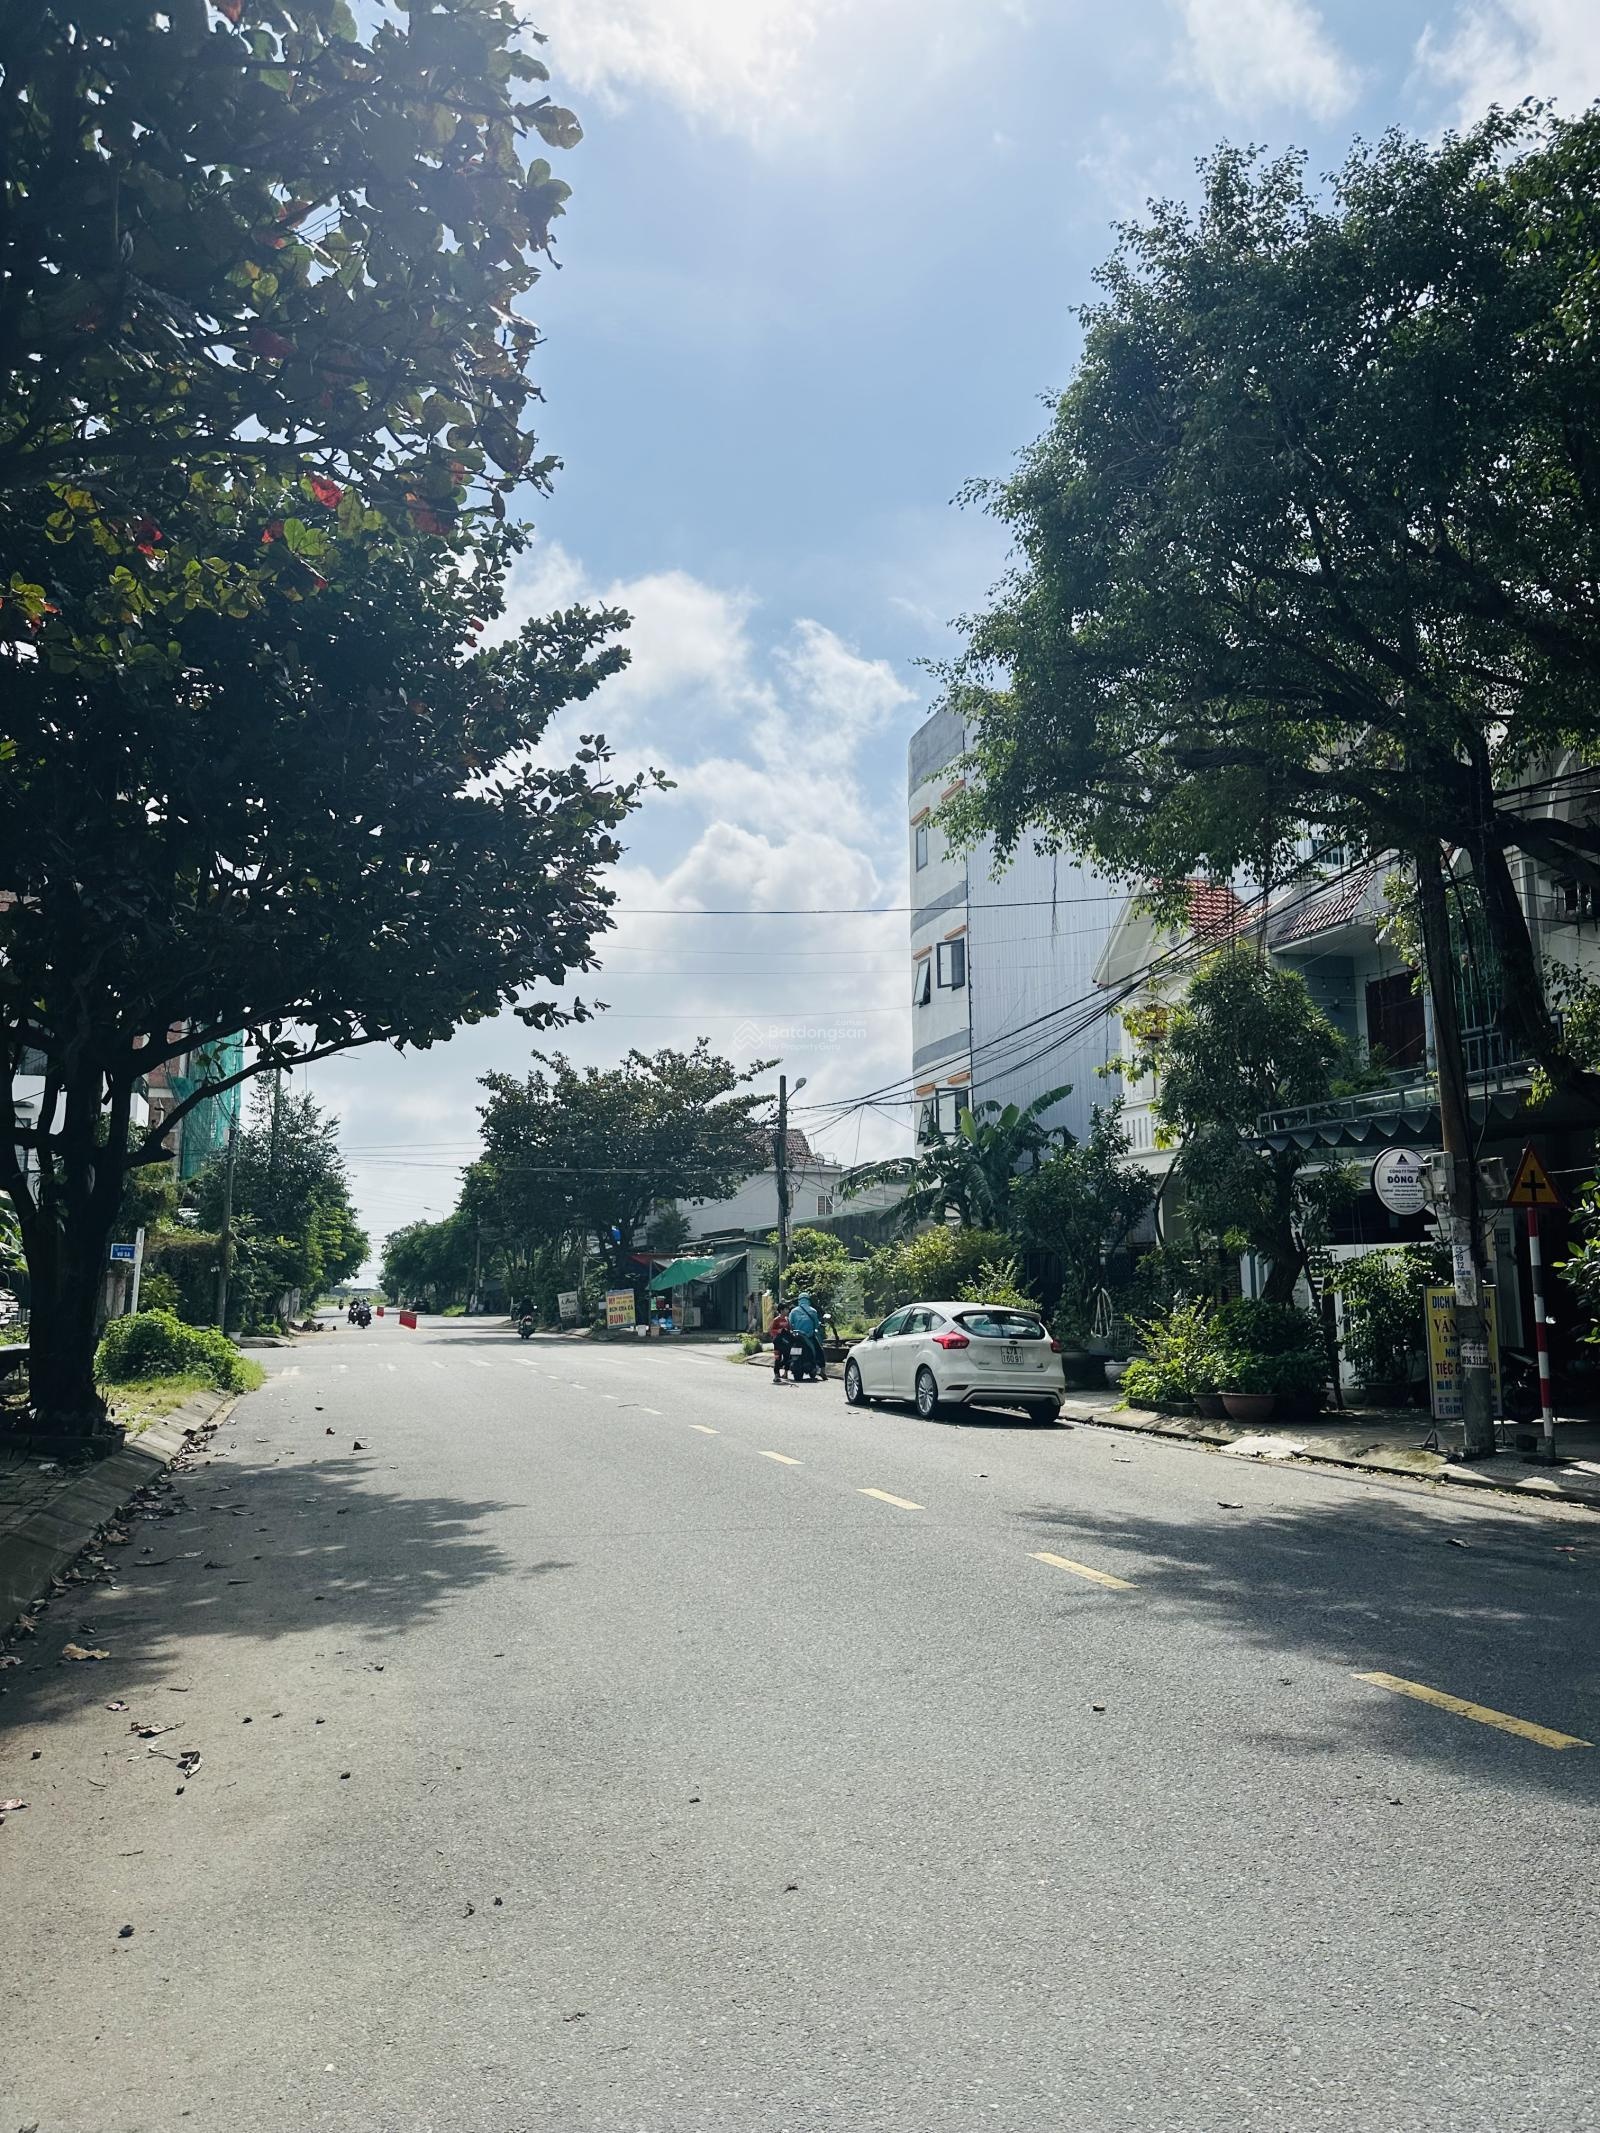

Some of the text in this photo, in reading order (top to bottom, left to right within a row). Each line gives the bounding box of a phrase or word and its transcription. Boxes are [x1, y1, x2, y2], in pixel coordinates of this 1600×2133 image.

[1387, 1174, 1414, 1184] ĐÔNG
[1432, 1295, 1450, 1311] DỊCH
[1435, 1359, 1453, 1378] TIỆC
